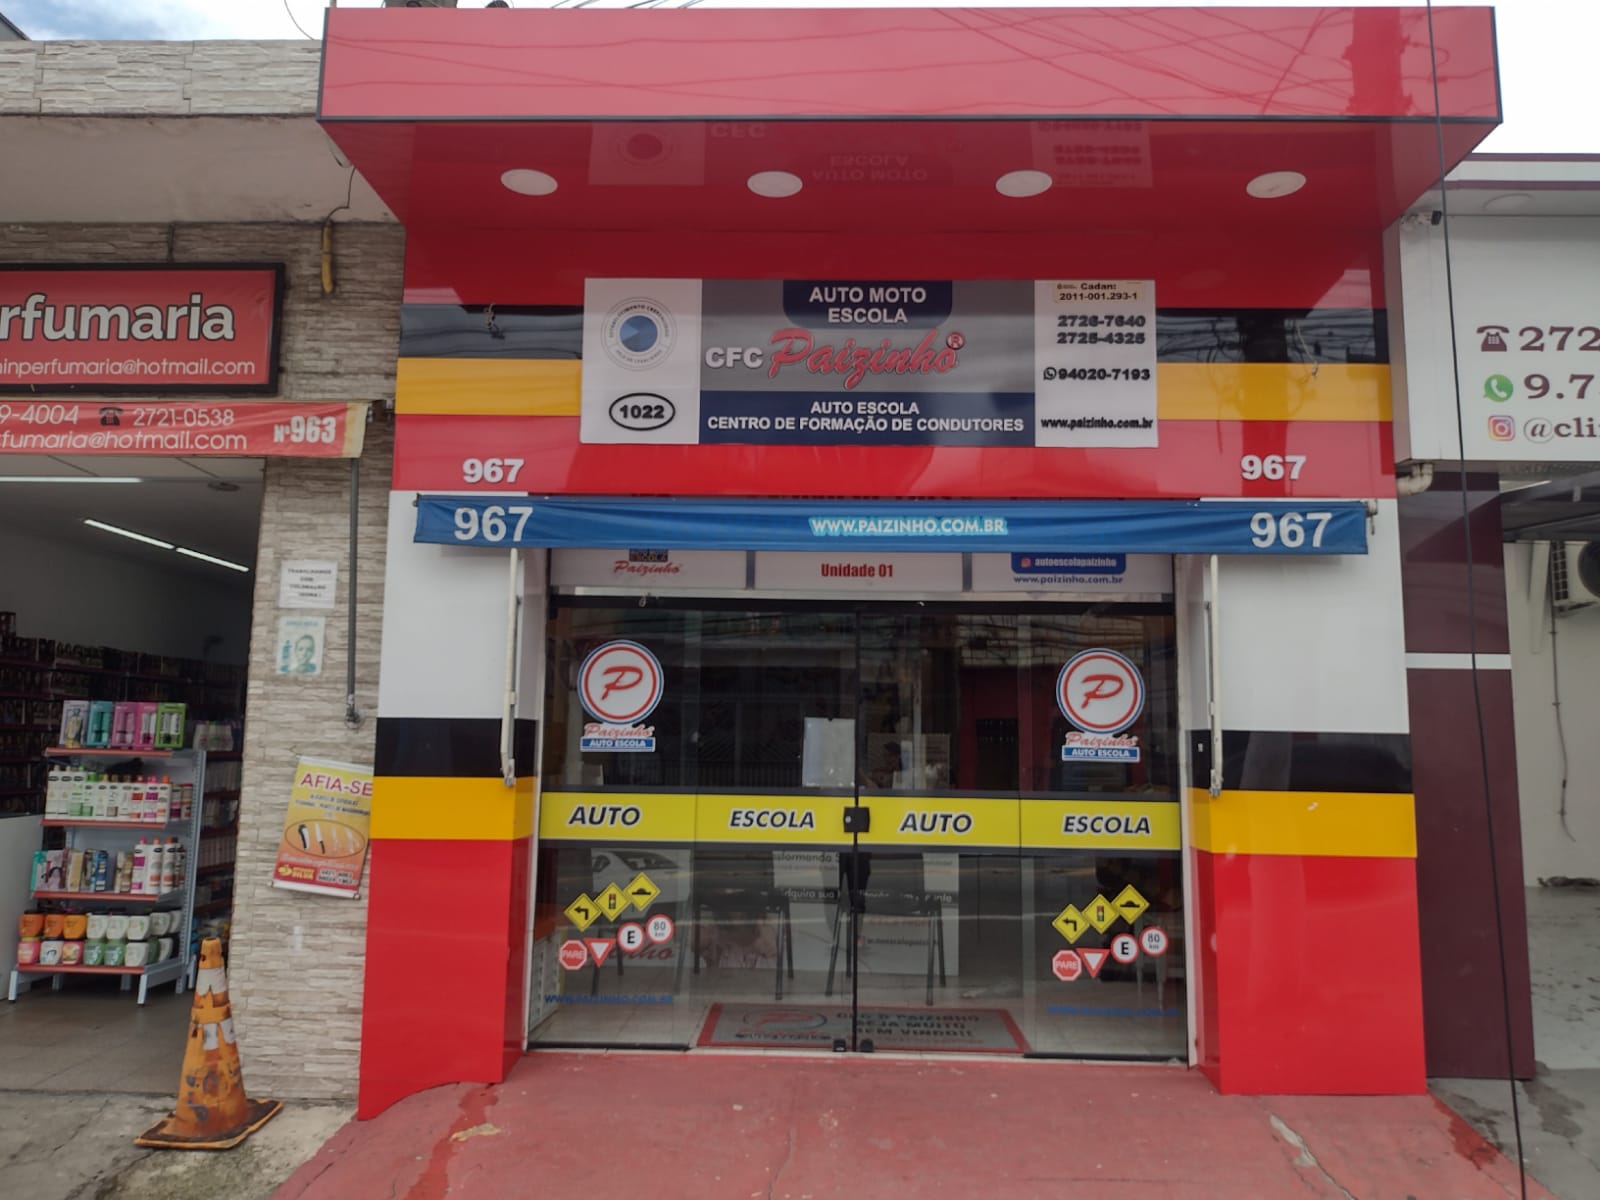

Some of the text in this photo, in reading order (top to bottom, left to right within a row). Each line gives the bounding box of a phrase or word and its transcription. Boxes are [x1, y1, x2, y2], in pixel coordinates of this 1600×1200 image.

[809, 287, 927, 304] AUTO MOTO
[0, 293, 235, 341] rfumaria
[828, 308, 908, 324] ESCOLA
[1518, 326, 1600, 352] 272
[704, 346, 765, 369] CFC
[1058, 367, 1151, 381] 94020-7193
[1523, 373, 1600, 400] 9.7
[0, 404, 235, 428] 9-4004 2721-0538
[619, 404, 665, 420] 1022
[810, 401, 920, 416] AUTO ESCOLA
[707, 415, 1025, 434] CENTRO DE FORMAÇÃO DE CONDUTORES
[1040, 416, 1154, 431] www.paizinho.com.br
[1522, 416, 1600, 445] @cli
[0, 430, 248, 450] fumaria@hotmail.com
[462, 458, 525, 483] 967
[1240, 454, 1307, 481] 967
[453, 505, 534, 543] 967
[810, 517, 1008, 537] WWW.PAIZINHO.COM.BR
[1250, 511, 1333, 549] 967
[613, 559, 682, 577] Paizinho
[821, 562, 894, 578] Unidade 01
[1013, 575, 1125, 586] www.paizinho.com.br
[584, 722, 653, 740] Paizinho
[589, 739, 646, 748] AUTO ESCOLA
[1066, 732, 1135, 749] Paizinho
[1071, 748, 1131, 758] AUTO ESCOLA
[300, 772, 374, 797] AFIA-SE
[568, 805, 1152, 835] AUTO ESCOLA AUTO ESCOLA
[653, 920, 667, 931] 80
[628, 931, 638, 944] E
[1147, 932, 1161, 943] 80
[560, 948, 586, 961] PARE
[1121, 942, 1129, 955] E
[1055, 959, 1079, 971] PARE
